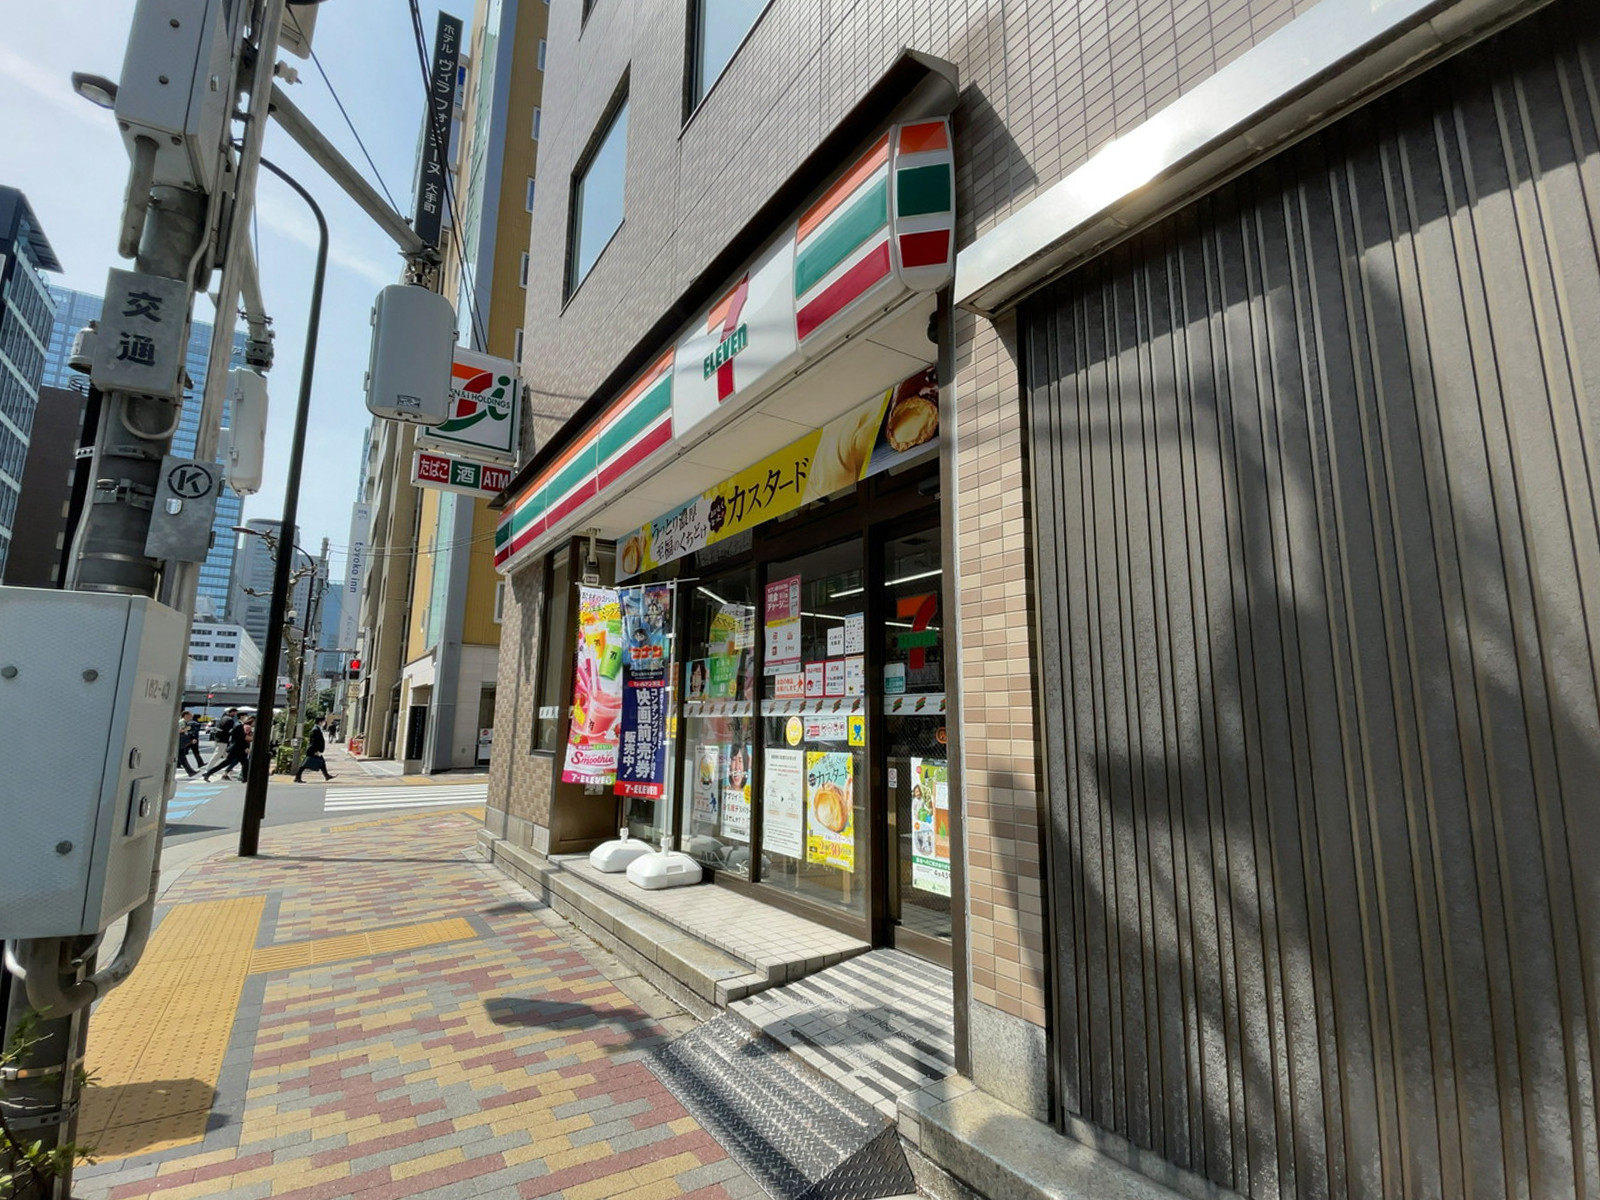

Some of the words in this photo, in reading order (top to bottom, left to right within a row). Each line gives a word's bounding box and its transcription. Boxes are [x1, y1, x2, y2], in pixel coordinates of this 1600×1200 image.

[423, 182, 438, 215] 大手町
[116, 292, 163, 367] 交通
[471, 394, 511, 409] HOLDINGS
[419, 459, 449, 479] たばこ
[456, 464, 476, 484] 酒
[483, 470, 510, 489] ATM
[728, 457, 809, 528] カスタード
[652, 502, 698, 546] うっとり濃厚
[351, 541, 364, 575] toyoko
[349, 576, 361, 593] inn
[629, 645, 664, 659] コナン
[635, 688, 652, 779] 映画前売券
[571, 751, 615, 767] Smoothie
[816, 767, 850, 788] カスタード
